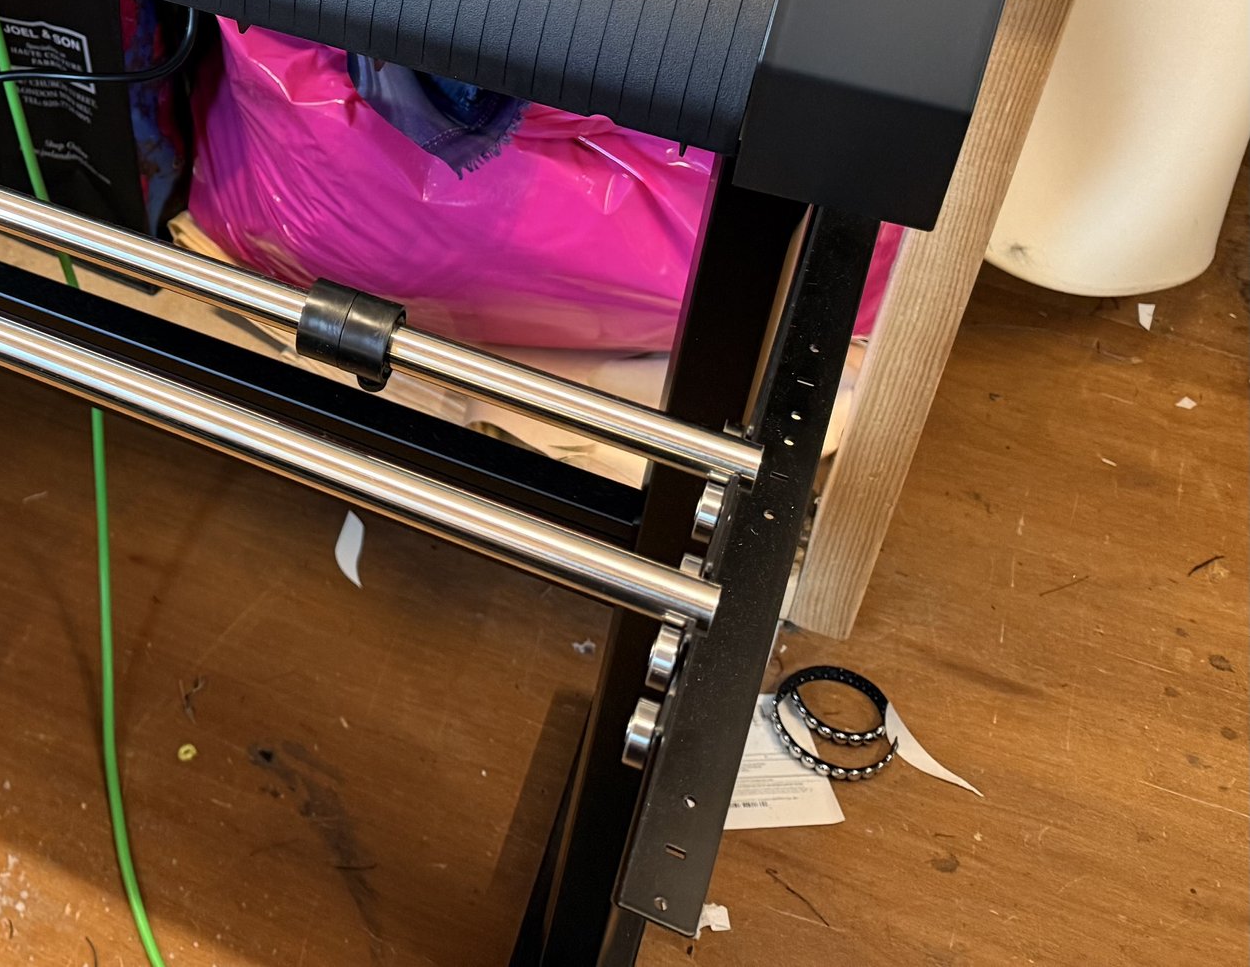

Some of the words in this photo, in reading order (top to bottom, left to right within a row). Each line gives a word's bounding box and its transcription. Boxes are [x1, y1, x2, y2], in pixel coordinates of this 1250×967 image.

[3, 24, 40, 39] JOEL
[41, 28, 52, 40] &
[52, 33, 82, 52] SON
[10, 46, 42, 59] HAUTE
